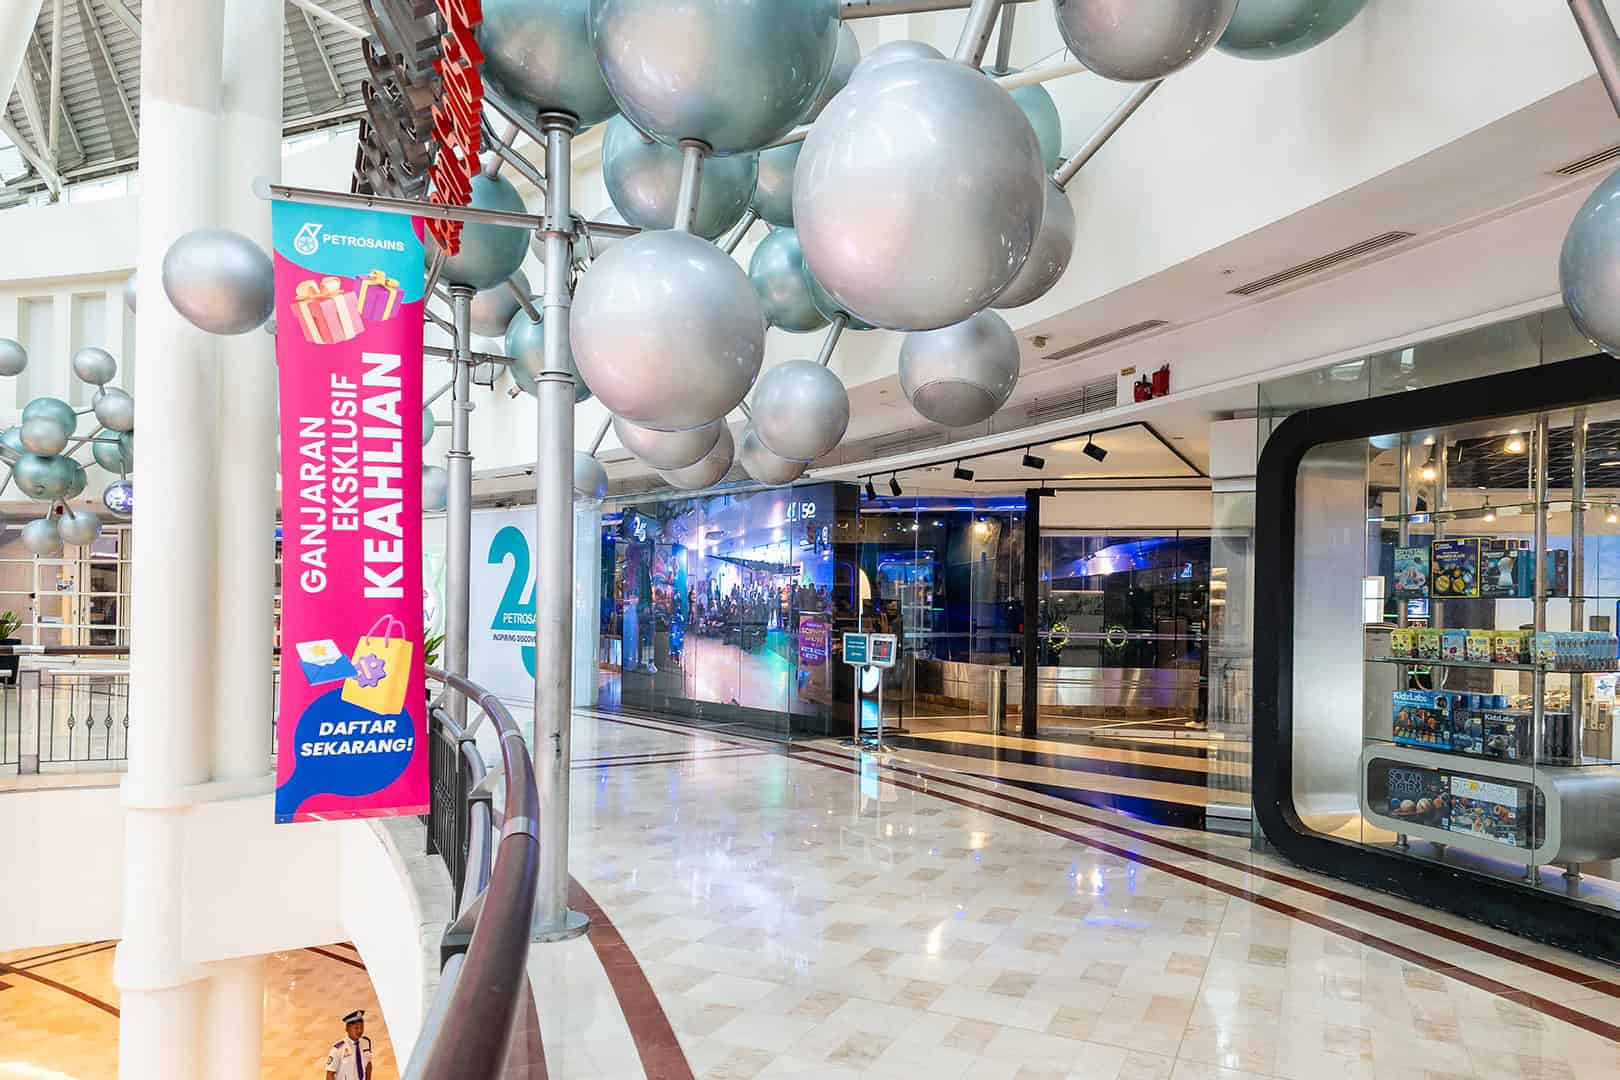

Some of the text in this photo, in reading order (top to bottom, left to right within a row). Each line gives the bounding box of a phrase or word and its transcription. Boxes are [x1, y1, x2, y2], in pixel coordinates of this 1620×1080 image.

[322, 233, 406, 252] PETROSAINS
[330, 372, 359, 531] EKSKLUSIF
[361, 351, 404, 599] KEAHLIAN
[299, 416, 327, 594] GANJARAN
[300, 737, 414, 757] SEKARANG!
[318, 719, 397, 737] DAFTAR
